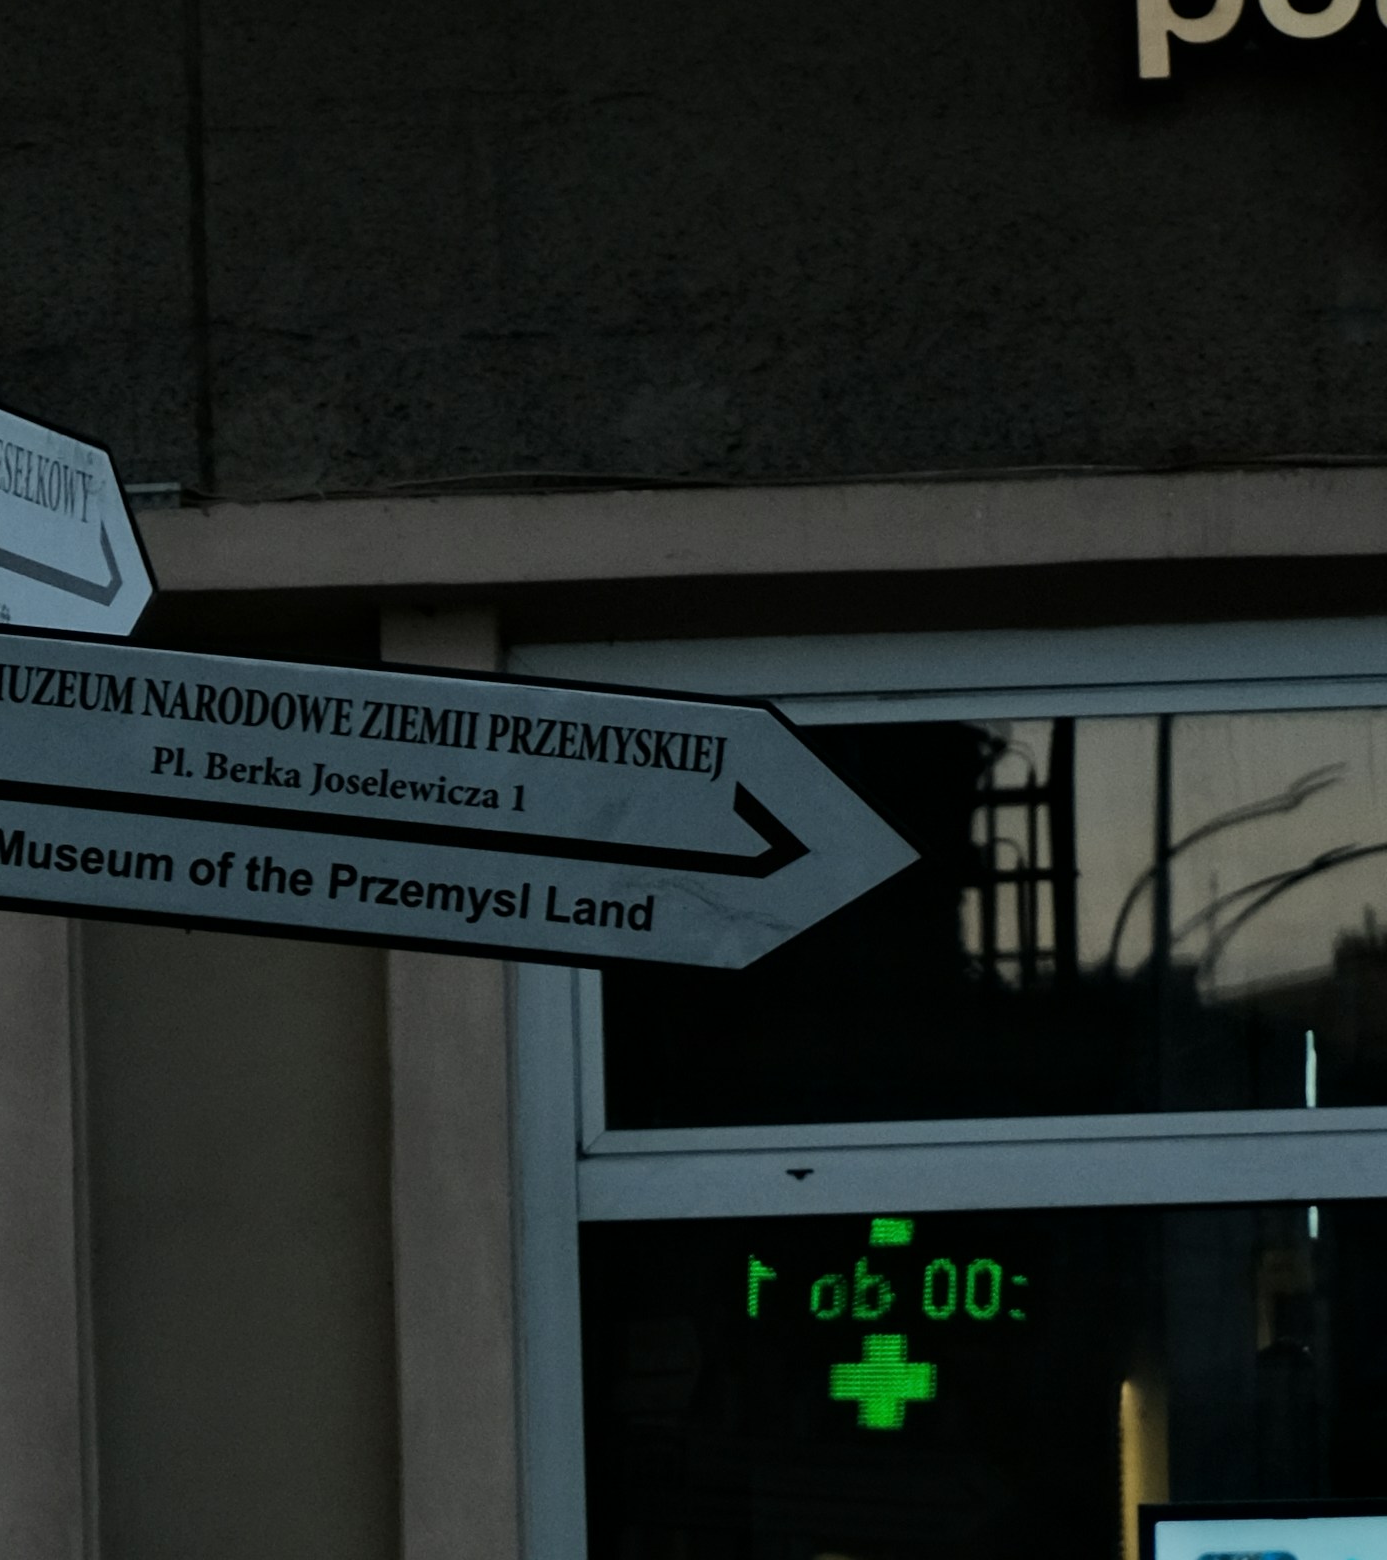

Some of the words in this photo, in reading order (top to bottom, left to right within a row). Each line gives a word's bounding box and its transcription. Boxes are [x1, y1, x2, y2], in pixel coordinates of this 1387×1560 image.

[140, 678, 354, 737] NARODOWE
[358, 700, 480, 750] ZIEMII
[485, 713, 728, 783] PRZEMYSKIEJ
[150, 746, 194, 778] Pl.
[203, 751, 302, 789] Berka
[309, 762, 500, 810] Joselewicza
[511, 784, 525, 812] 1
[188, 851, 236, 889] of
[245, 855, 314, 897] the
[328, 862, 531, 924] Przemysl
[545, 885, 655, 932] Land
